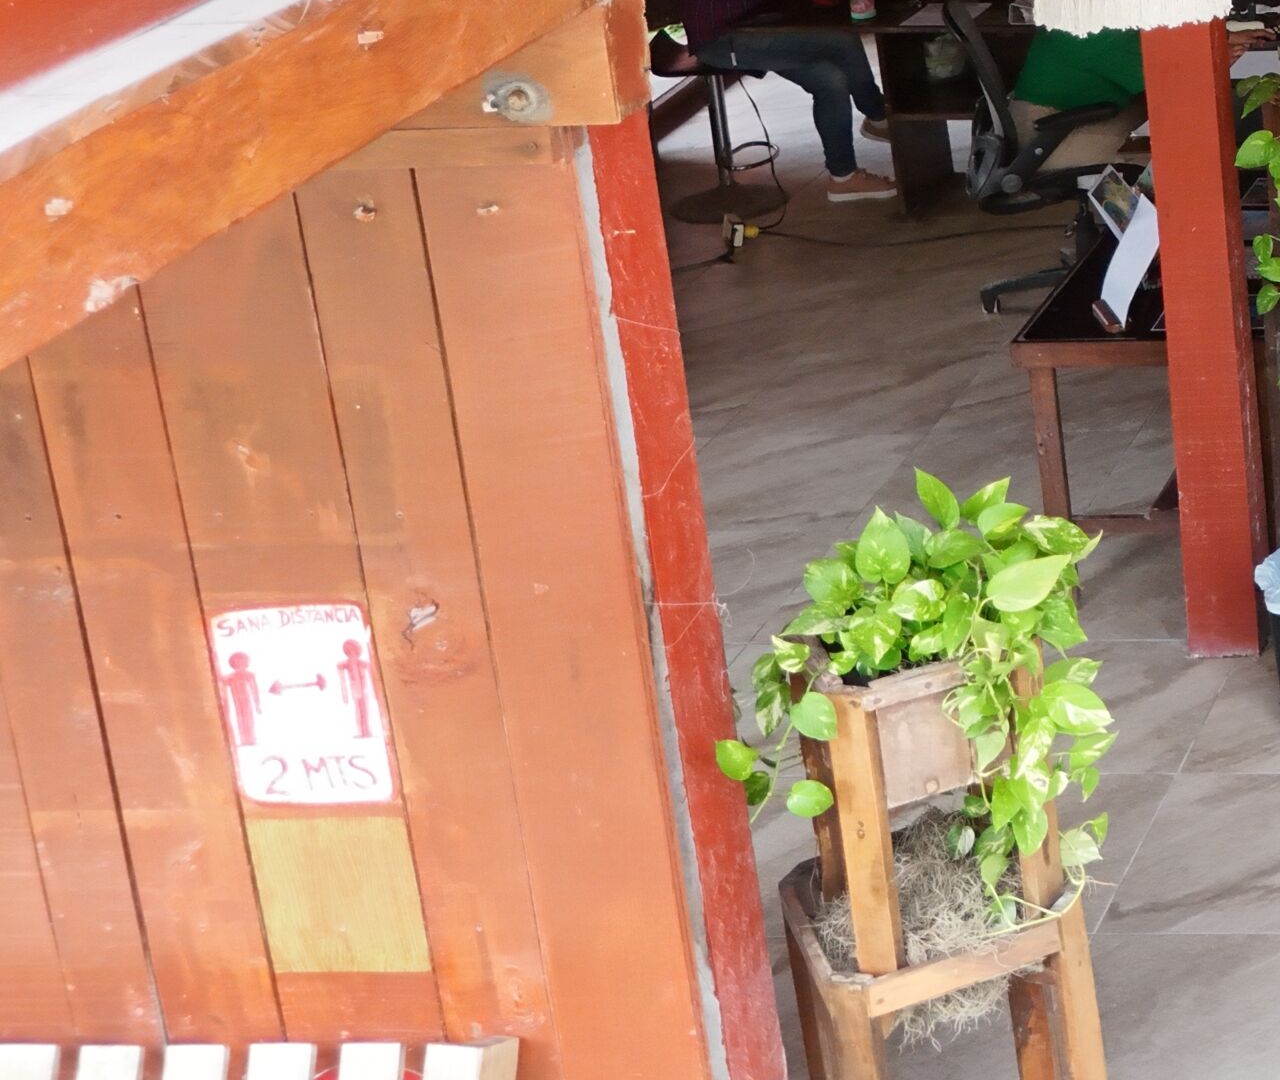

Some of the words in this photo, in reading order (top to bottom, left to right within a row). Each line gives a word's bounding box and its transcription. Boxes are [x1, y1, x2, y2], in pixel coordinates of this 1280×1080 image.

[216, 614, 273, 638] SANA
[277, 607, 361, 628] DISTANCIA
[260, 754, 291, 797] 2
[301, 754, 377, 792] MTS
